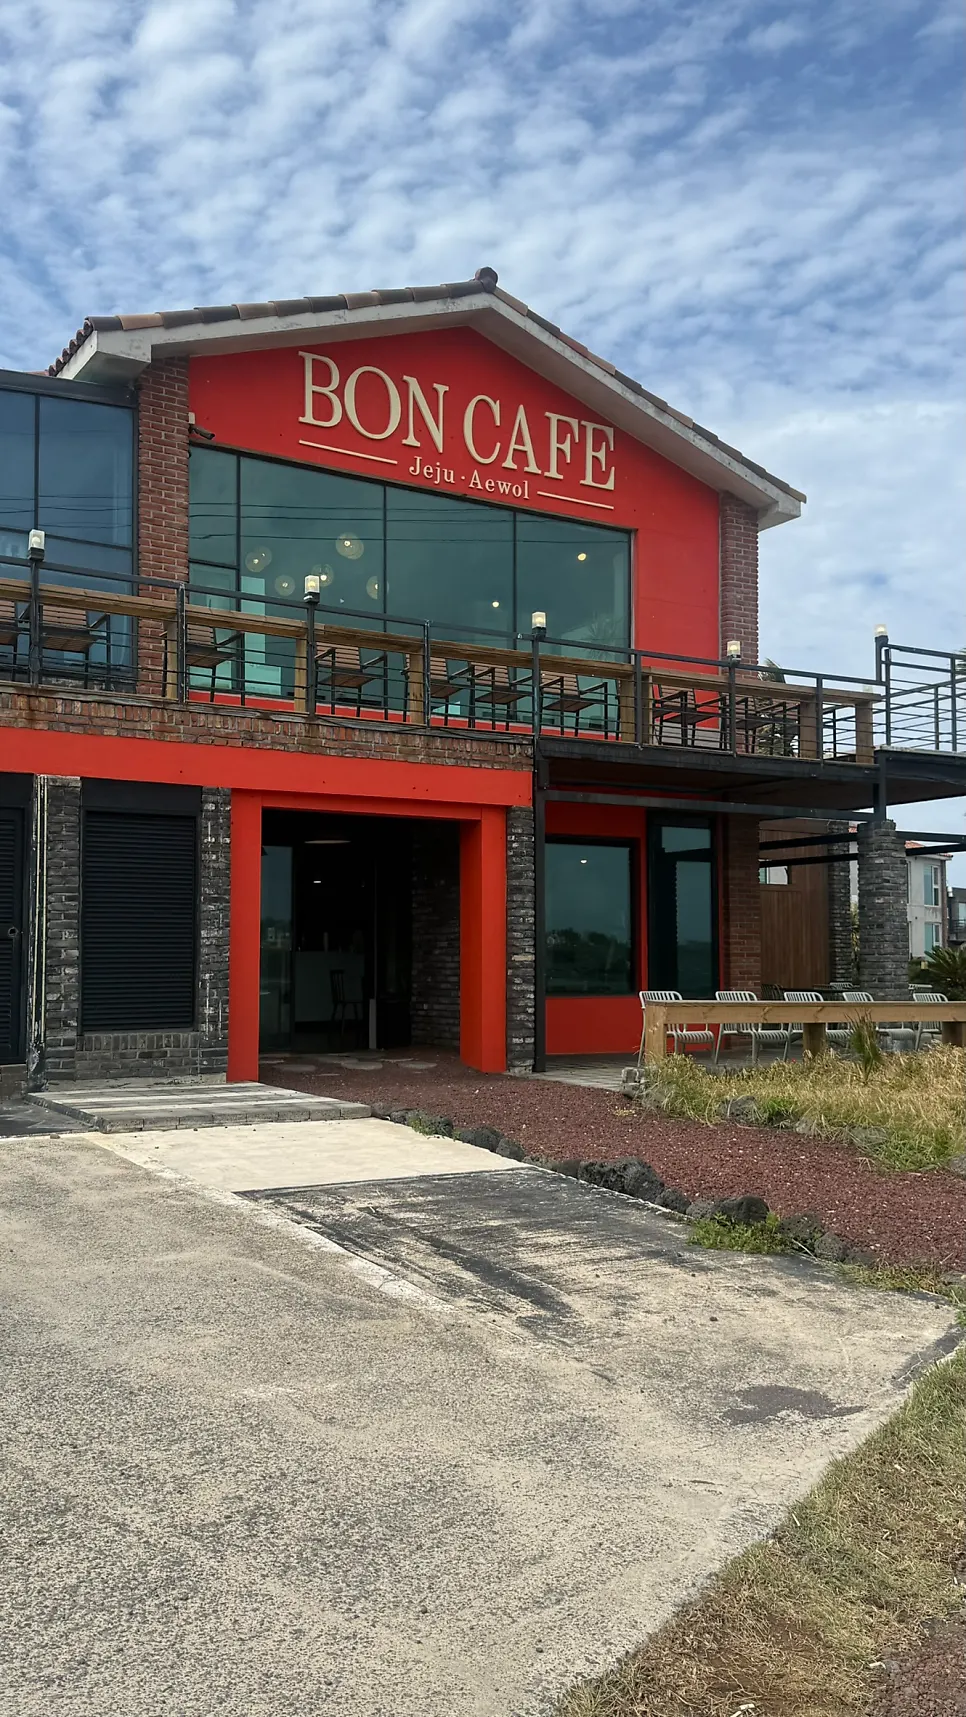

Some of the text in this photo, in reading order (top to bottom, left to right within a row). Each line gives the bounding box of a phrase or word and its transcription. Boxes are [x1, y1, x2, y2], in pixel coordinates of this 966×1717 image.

[298, 350, 615, 491] BON CAFE
[408, 455, 529, 499] Jeju Aewol
